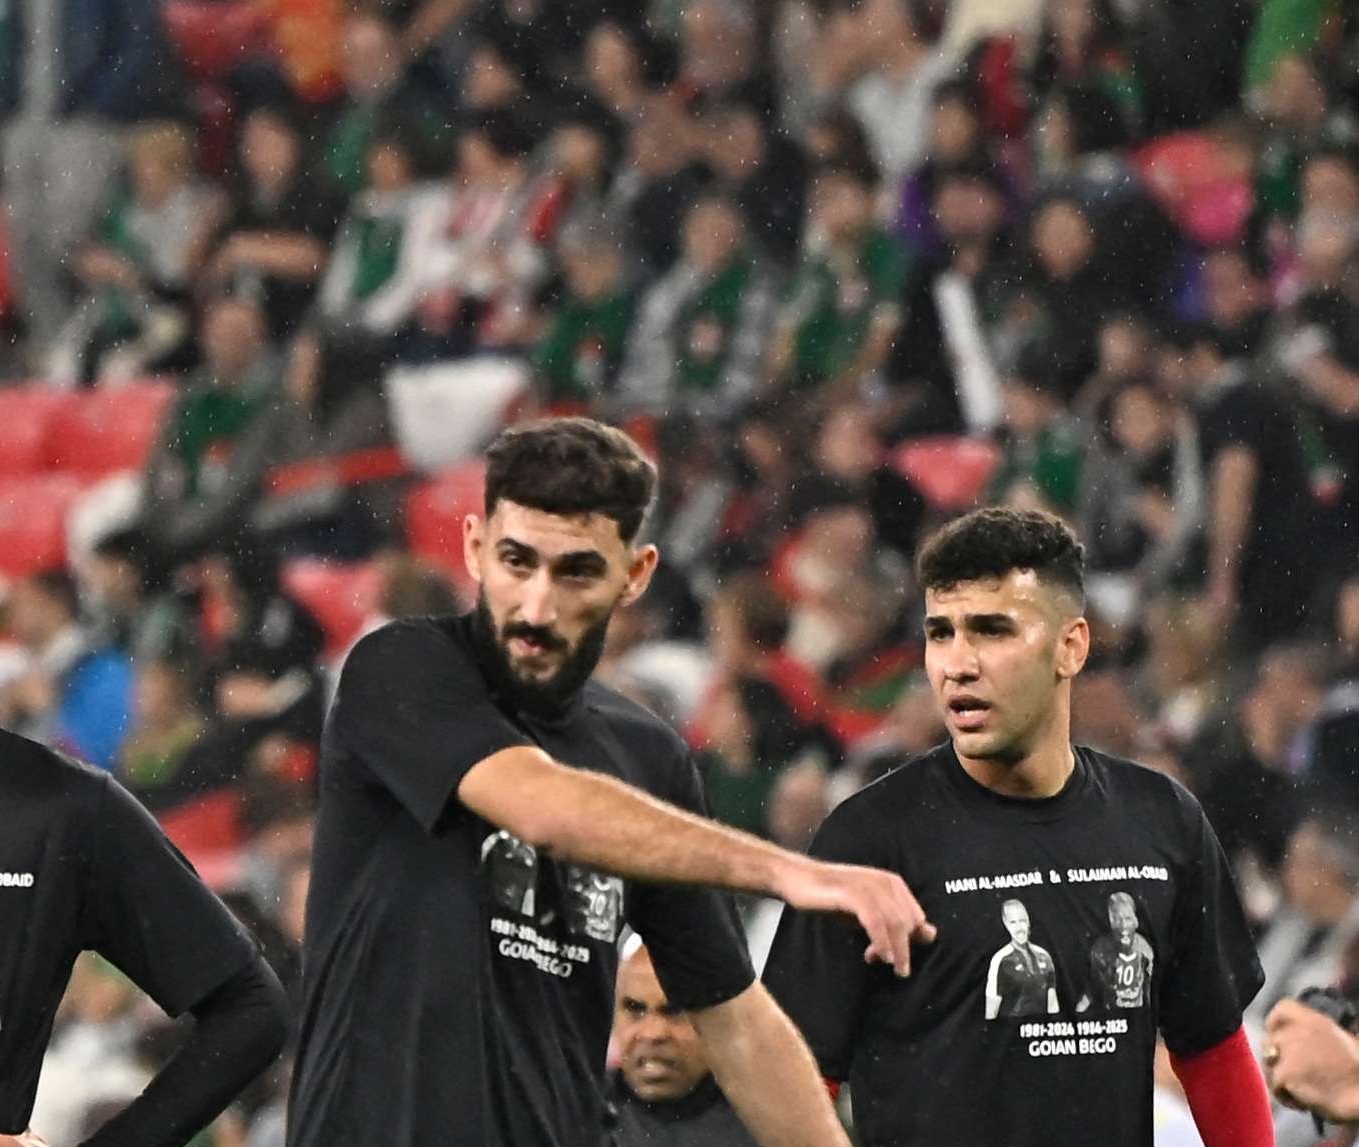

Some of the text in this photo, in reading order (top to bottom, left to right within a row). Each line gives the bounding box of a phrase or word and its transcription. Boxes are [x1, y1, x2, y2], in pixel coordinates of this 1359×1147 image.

[945, 877, 977, 894] HANI
[978, 871, 1043, 890] AL-MASDAR
[1049, 870, 1061, 883] &
[1067, 866, 1127, 883] SULAIMAN
[1116, 965, 1133, 985] 10
[1020, 1019, 1128, 1038] 1981-2024 1984-2025
[1029, 1037, 1116, 1057] GOIAN BEGO
